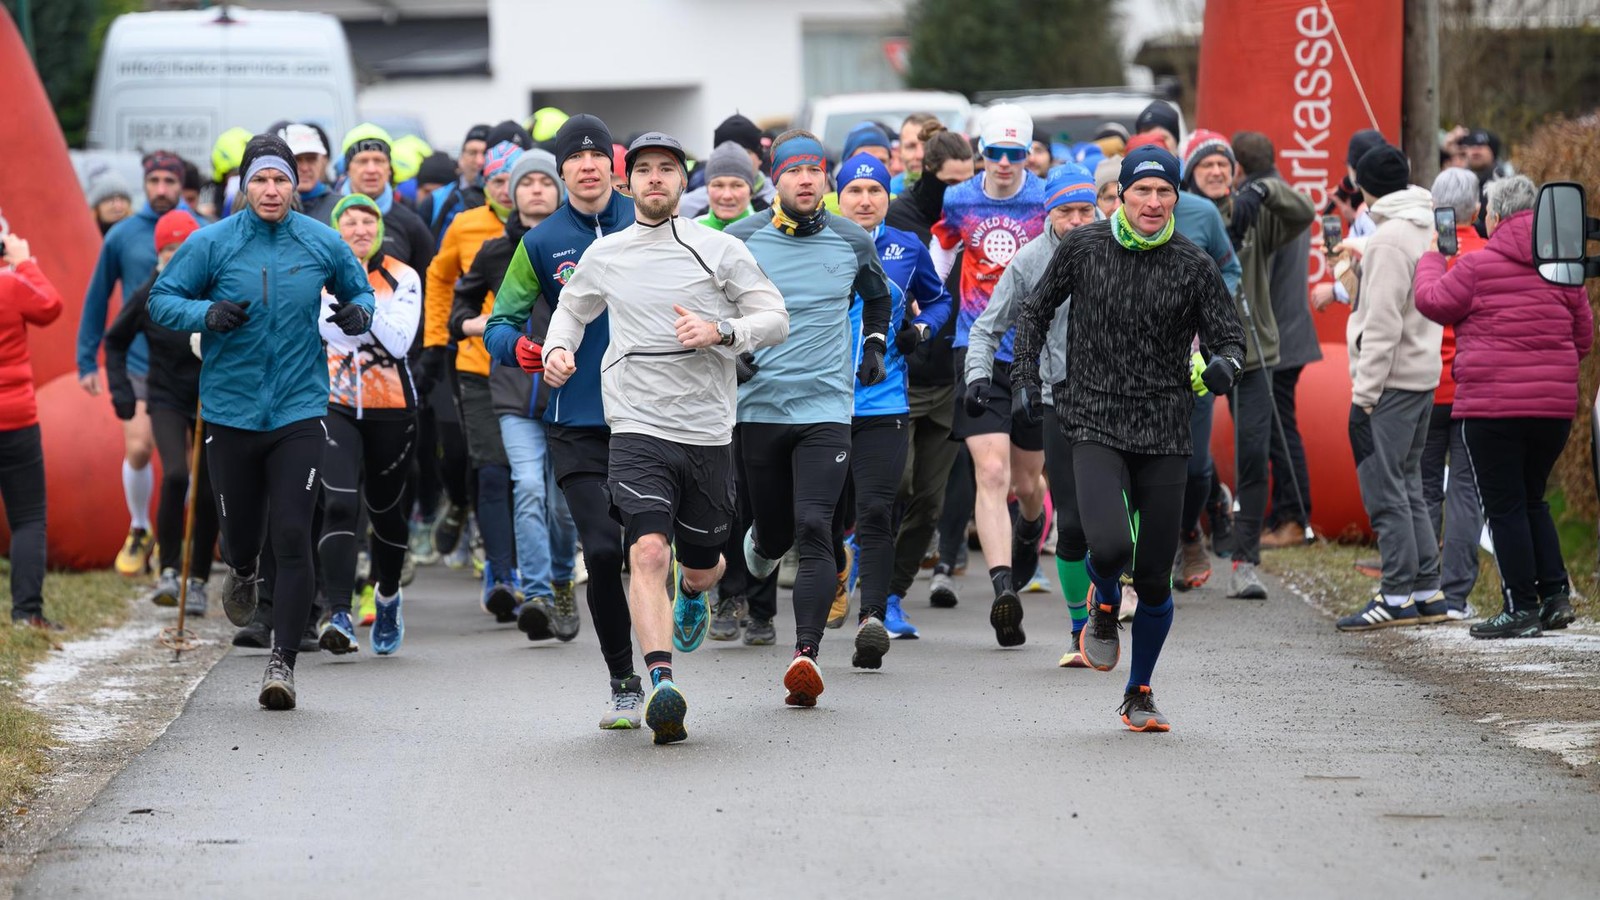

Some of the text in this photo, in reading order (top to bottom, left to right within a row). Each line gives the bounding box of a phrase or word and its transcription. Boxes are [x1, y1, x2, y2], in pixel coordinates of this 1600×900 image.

[1280, 5, 1334, 284] arkasse
[856, 164, 875, 175] LTV
[971, 216, 1029, 249] UNITED STATE
[552, 249, 572, 259] CRAFT
[885, 243, 906, 256] LTV
[305, 467, 316, 491] FUSION
